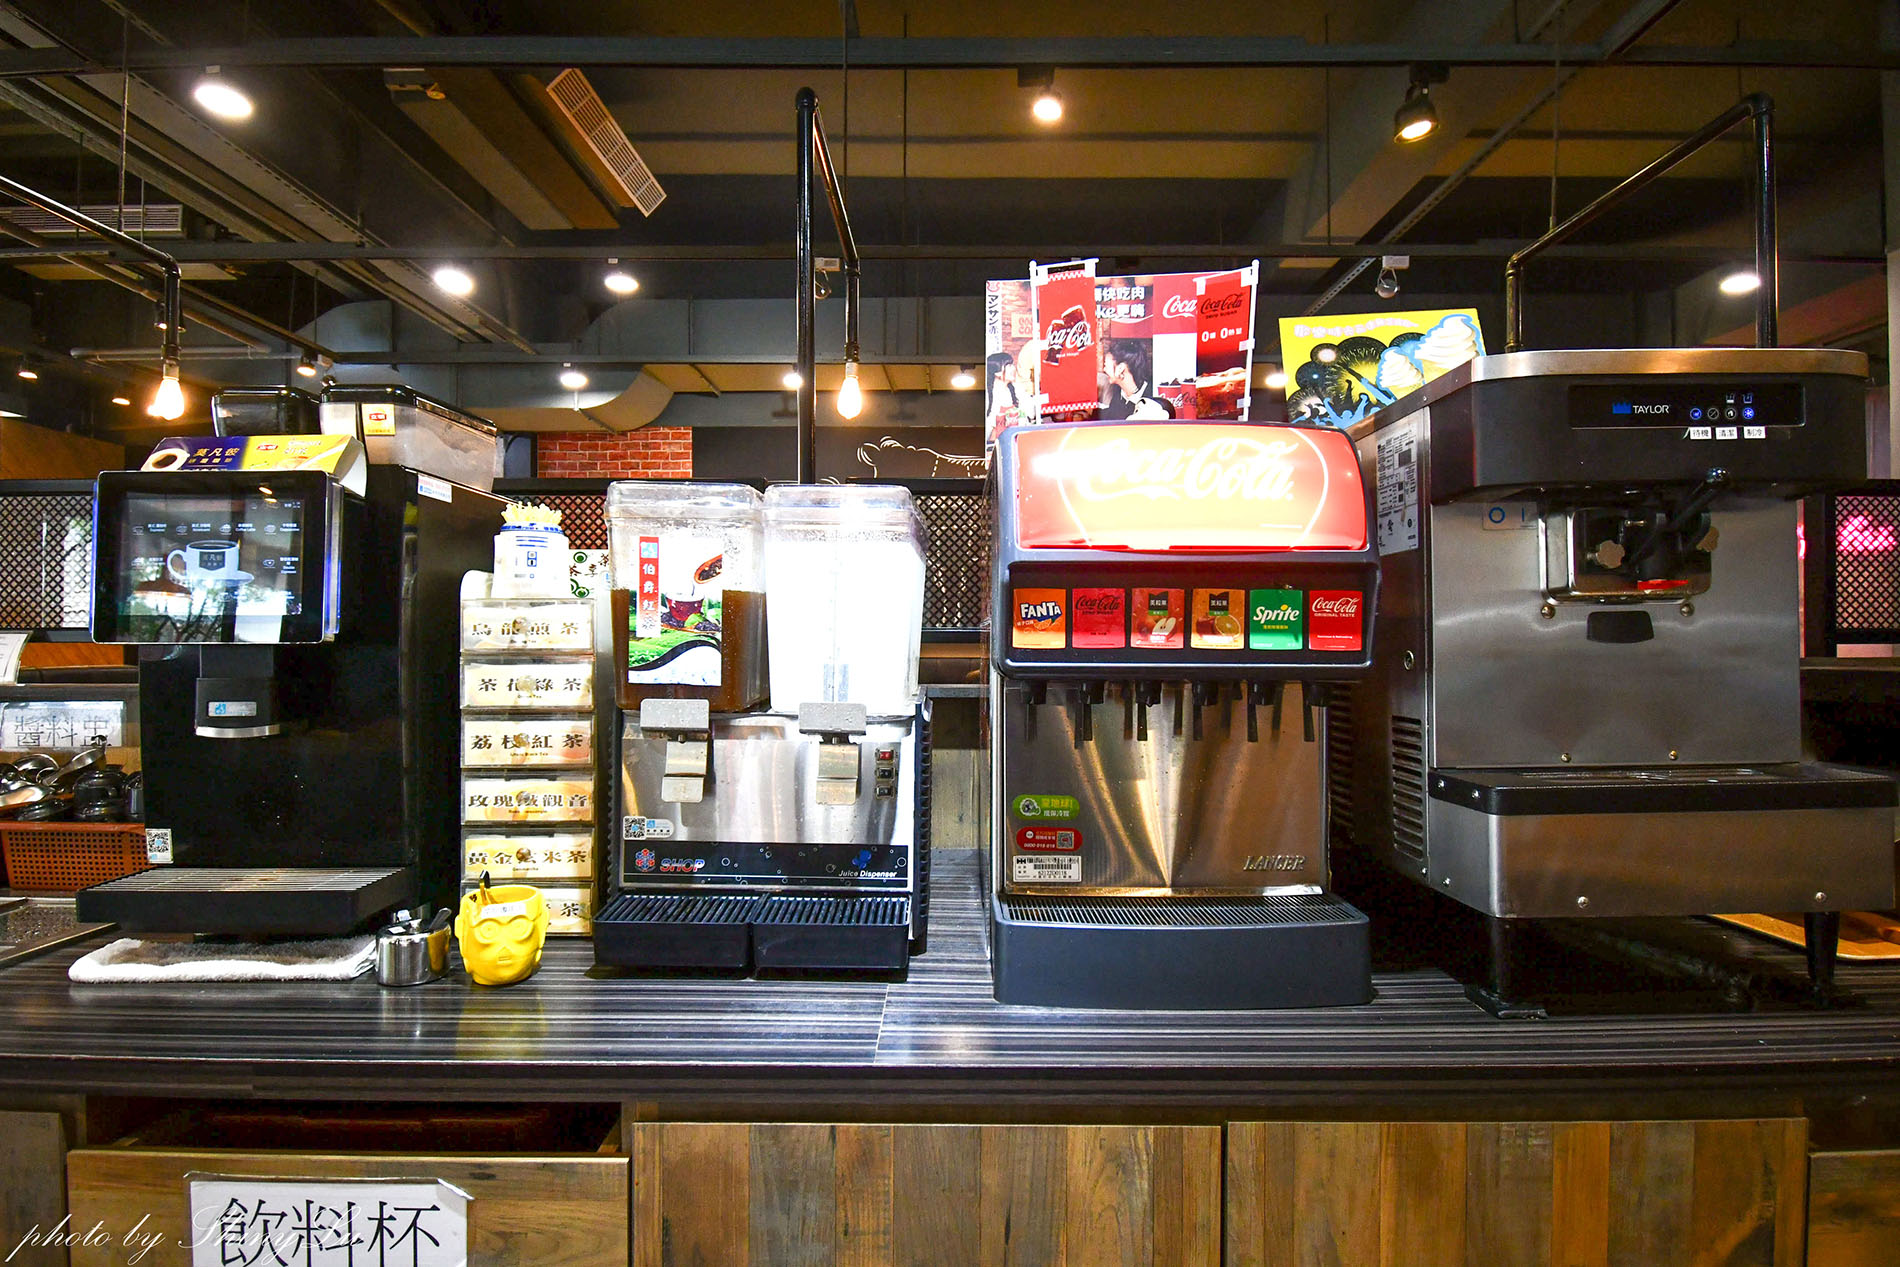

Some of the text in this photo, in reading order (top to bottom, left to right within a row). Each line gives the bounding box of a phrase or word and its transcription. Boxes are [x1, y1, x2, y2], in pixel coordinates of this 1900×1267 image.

[1632, 404, 1670, 414] TAYLOR
[1692, 428, 1709, 438] 待機
[1072, 437, 1299, 500] Coca-Cola
[641, 563, 656, 630] 伯爵紅茶
[1075, 595, 1120, 611] Coca-Cola
[1020, 601, 1062, 619] FANTA
[1312, 597, 1360, 613] Coca-Cola
[1253, 604, 1300, 625] Sprite
[471, 734, 584, 750] 荔枝紅茶
[660, 858, 705, 872] SHOP
[1242, 855, 1306, 871] LANCER
[859, 870, 897, 879] Dispenser
[217, 1197, 442, 1267] 飲料杯
